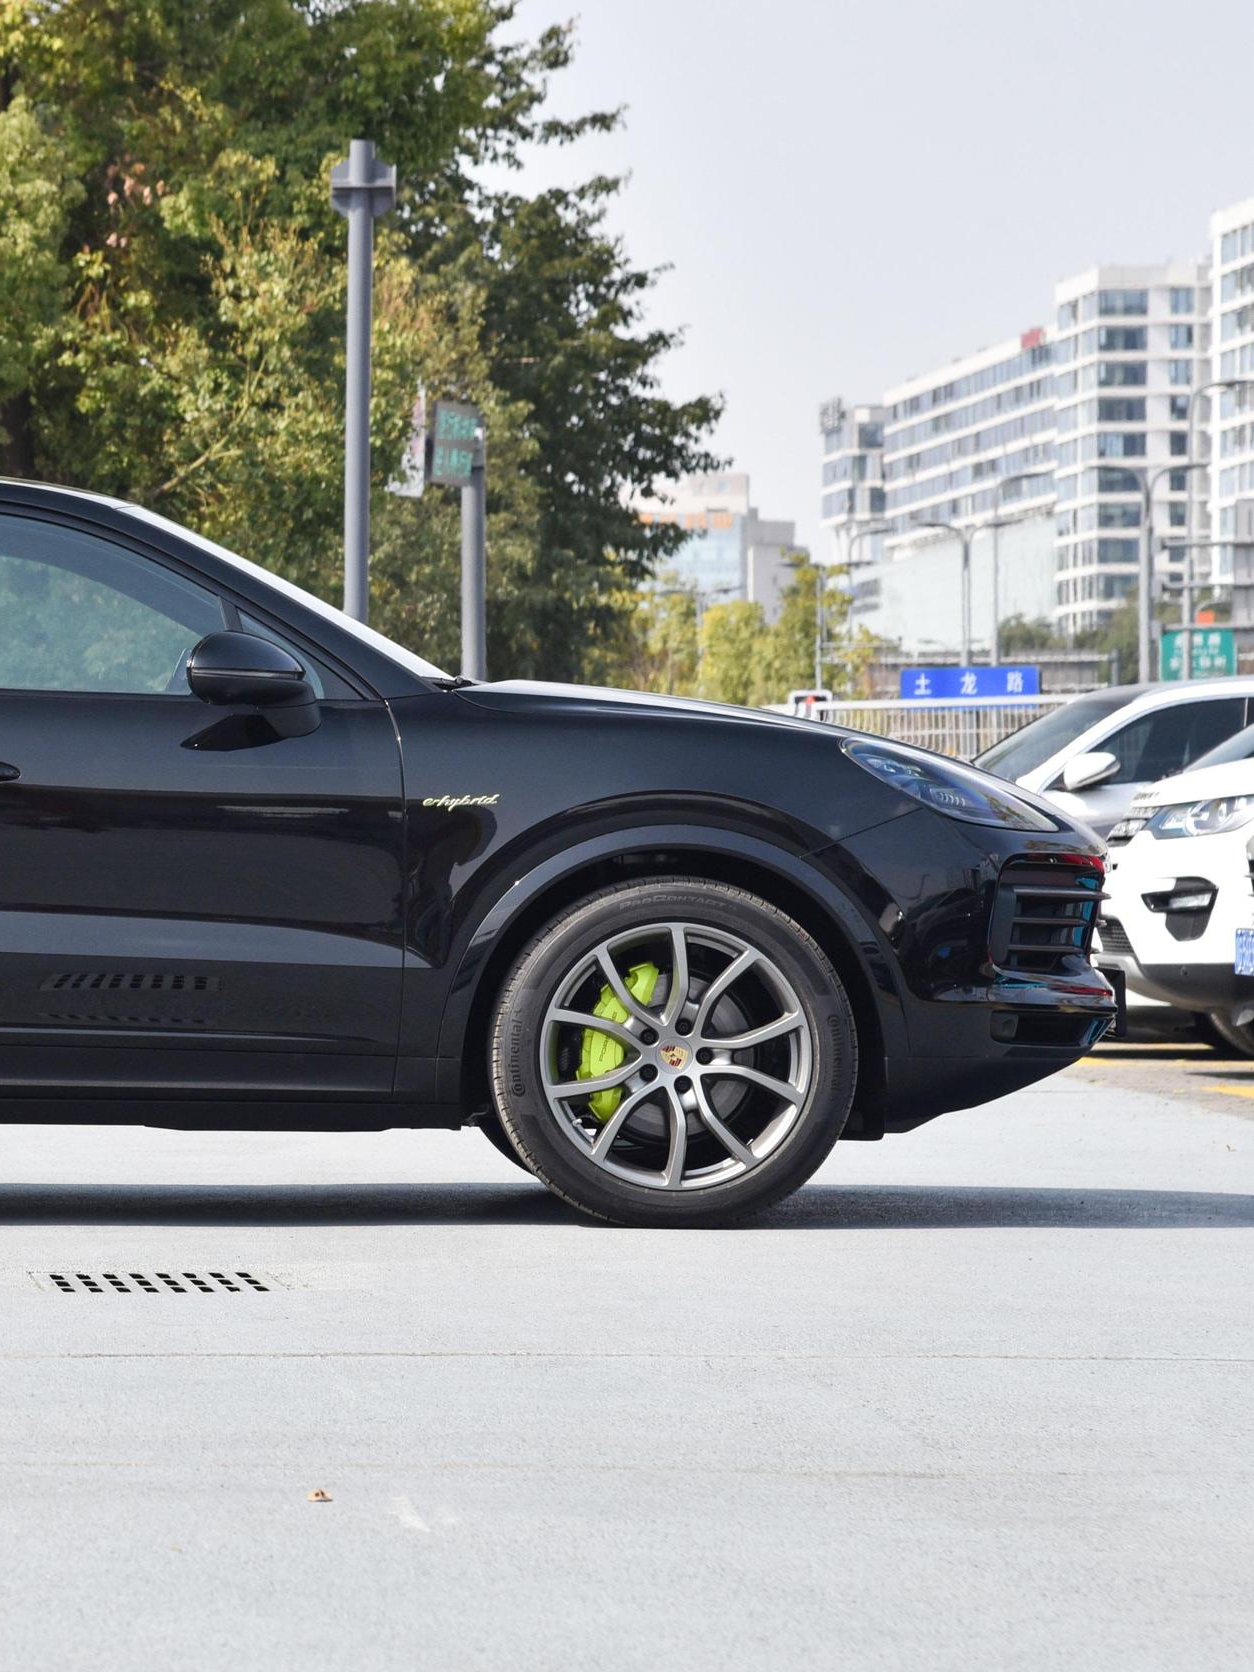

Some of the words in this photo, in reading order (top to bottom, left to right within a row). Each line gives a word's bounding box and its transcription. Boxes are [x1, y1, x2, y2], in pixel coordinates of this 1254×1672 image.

[913, 672, 1023, 695] 土龙路
[508, 1019, 525, 1096] Continental
